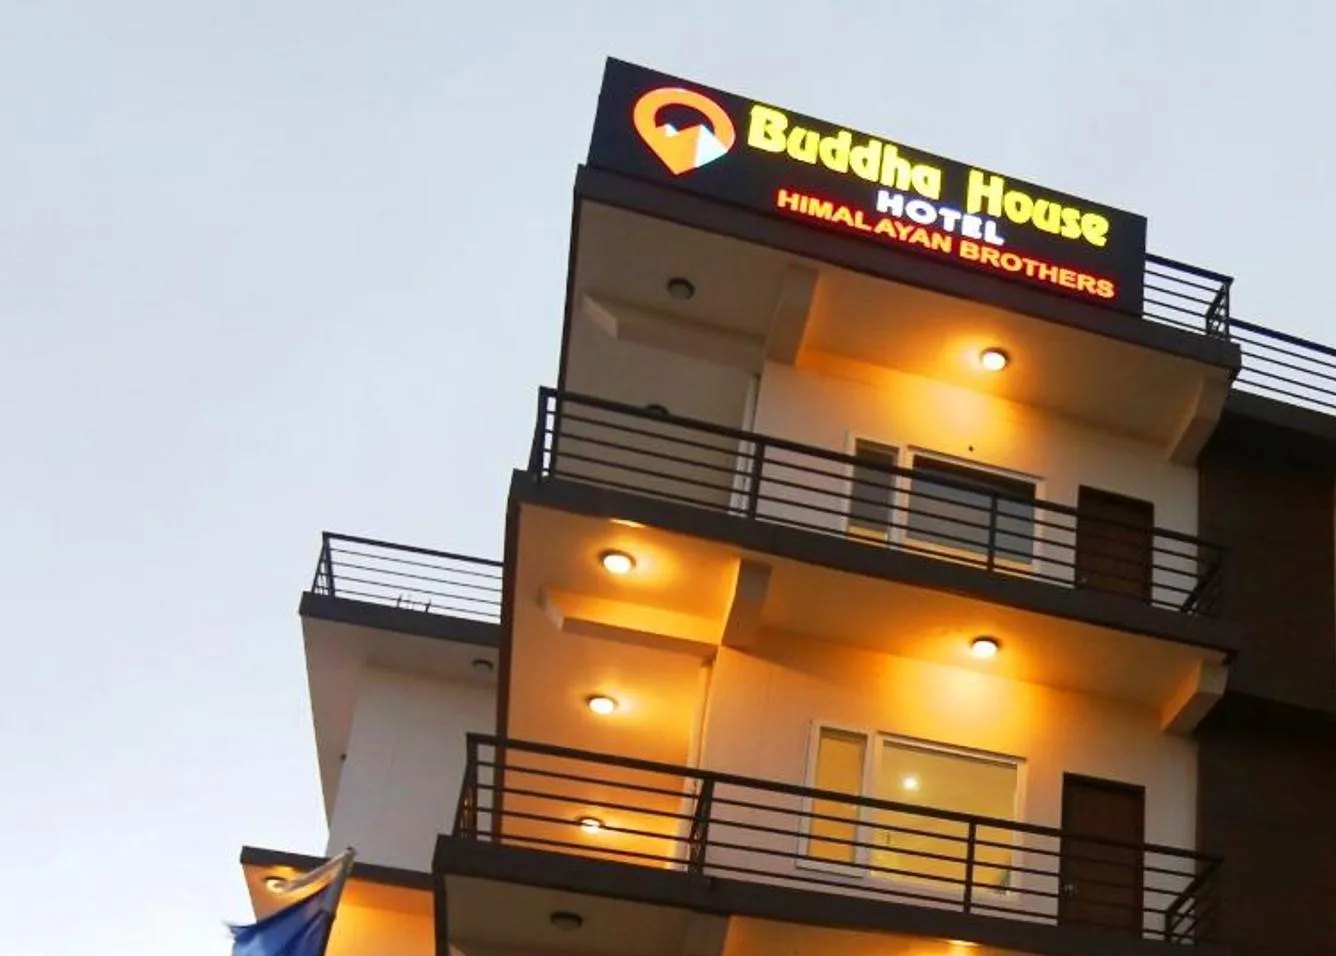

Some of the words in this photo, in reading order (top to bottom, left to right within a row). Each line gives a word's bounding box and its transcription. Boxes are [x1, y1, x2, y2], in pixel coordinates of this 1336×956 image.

[748, 105, 942, 200] Buddha
[967, 169, 1110, 247] House
[877, 191, 1004, 245] HOTEL
[777, 190, 952, 253] HIMALAYAN
[959, 241, 1115, 298] BROTHERS
